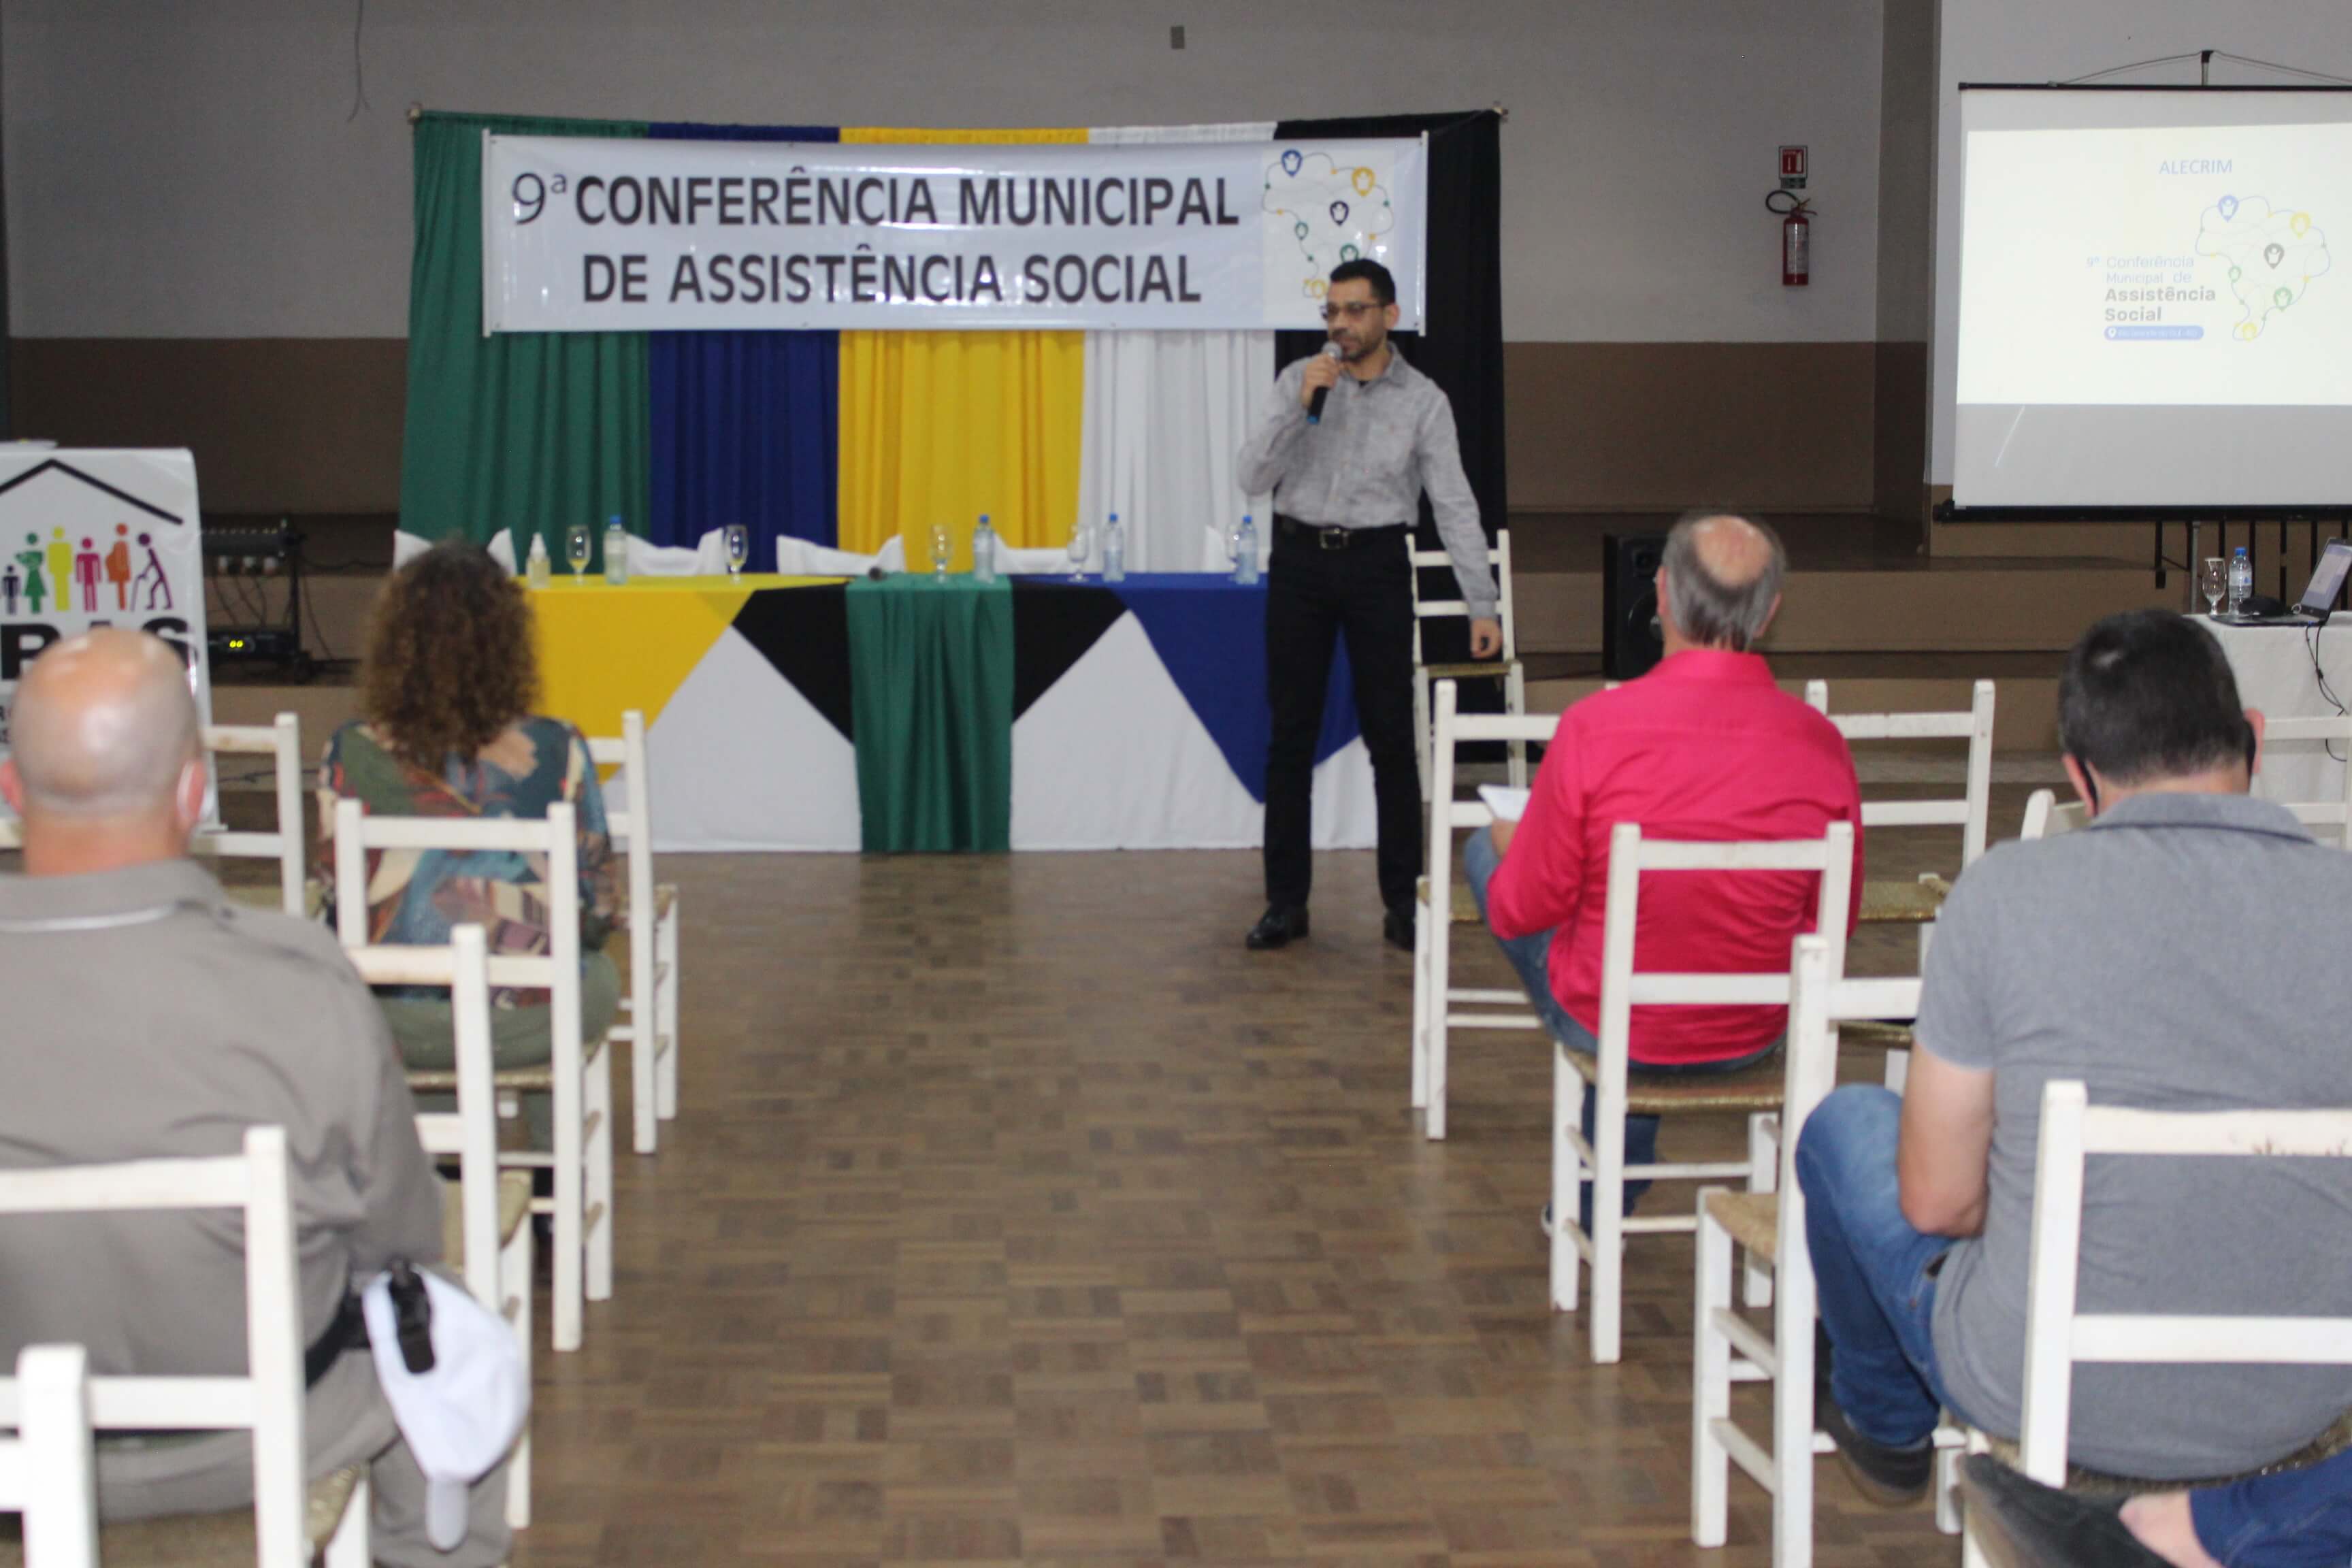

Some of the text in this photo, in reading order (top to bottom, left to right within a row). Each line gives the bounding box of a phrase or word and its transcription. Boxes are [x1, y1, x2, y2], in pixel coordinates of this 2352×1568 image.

[2159, 159, 2233, 175] ALECRIM
[575, 165, 938, 225] CONFERÊNCIA
[958, 178, 1239, 225] MUNICIPAL
[583, 243, 1202, 303] DE ASSISTÊNCIA SOCIAL
[2106, 271, 2191, 285] Municipal de
[2104, 286, 2216, 301] Assistência
[2104, 306, 2161, 322] Social
